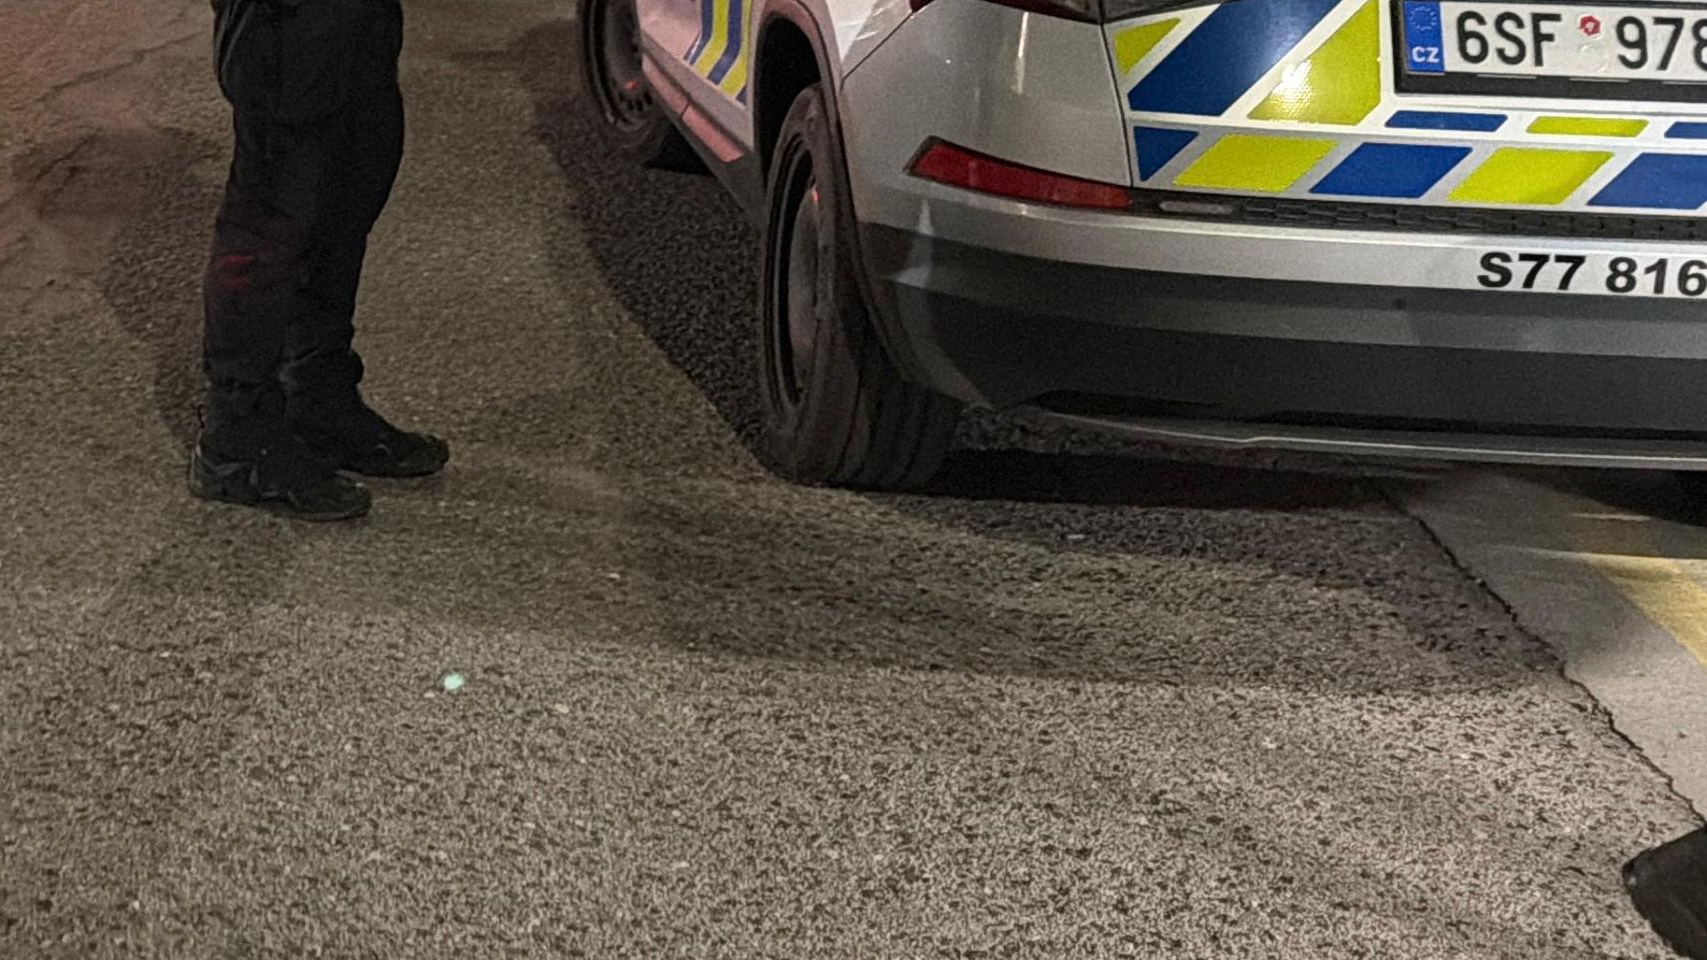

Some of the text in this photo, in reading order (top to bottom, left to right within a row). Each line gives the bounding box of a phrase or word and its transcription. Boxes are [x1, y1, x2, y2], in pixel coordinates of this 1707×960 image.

[1411, 45, 1440, 64] CZ
[1456, 10, 1562, 67] 6SF
[1477, 251, 1707, 297] S77 816
